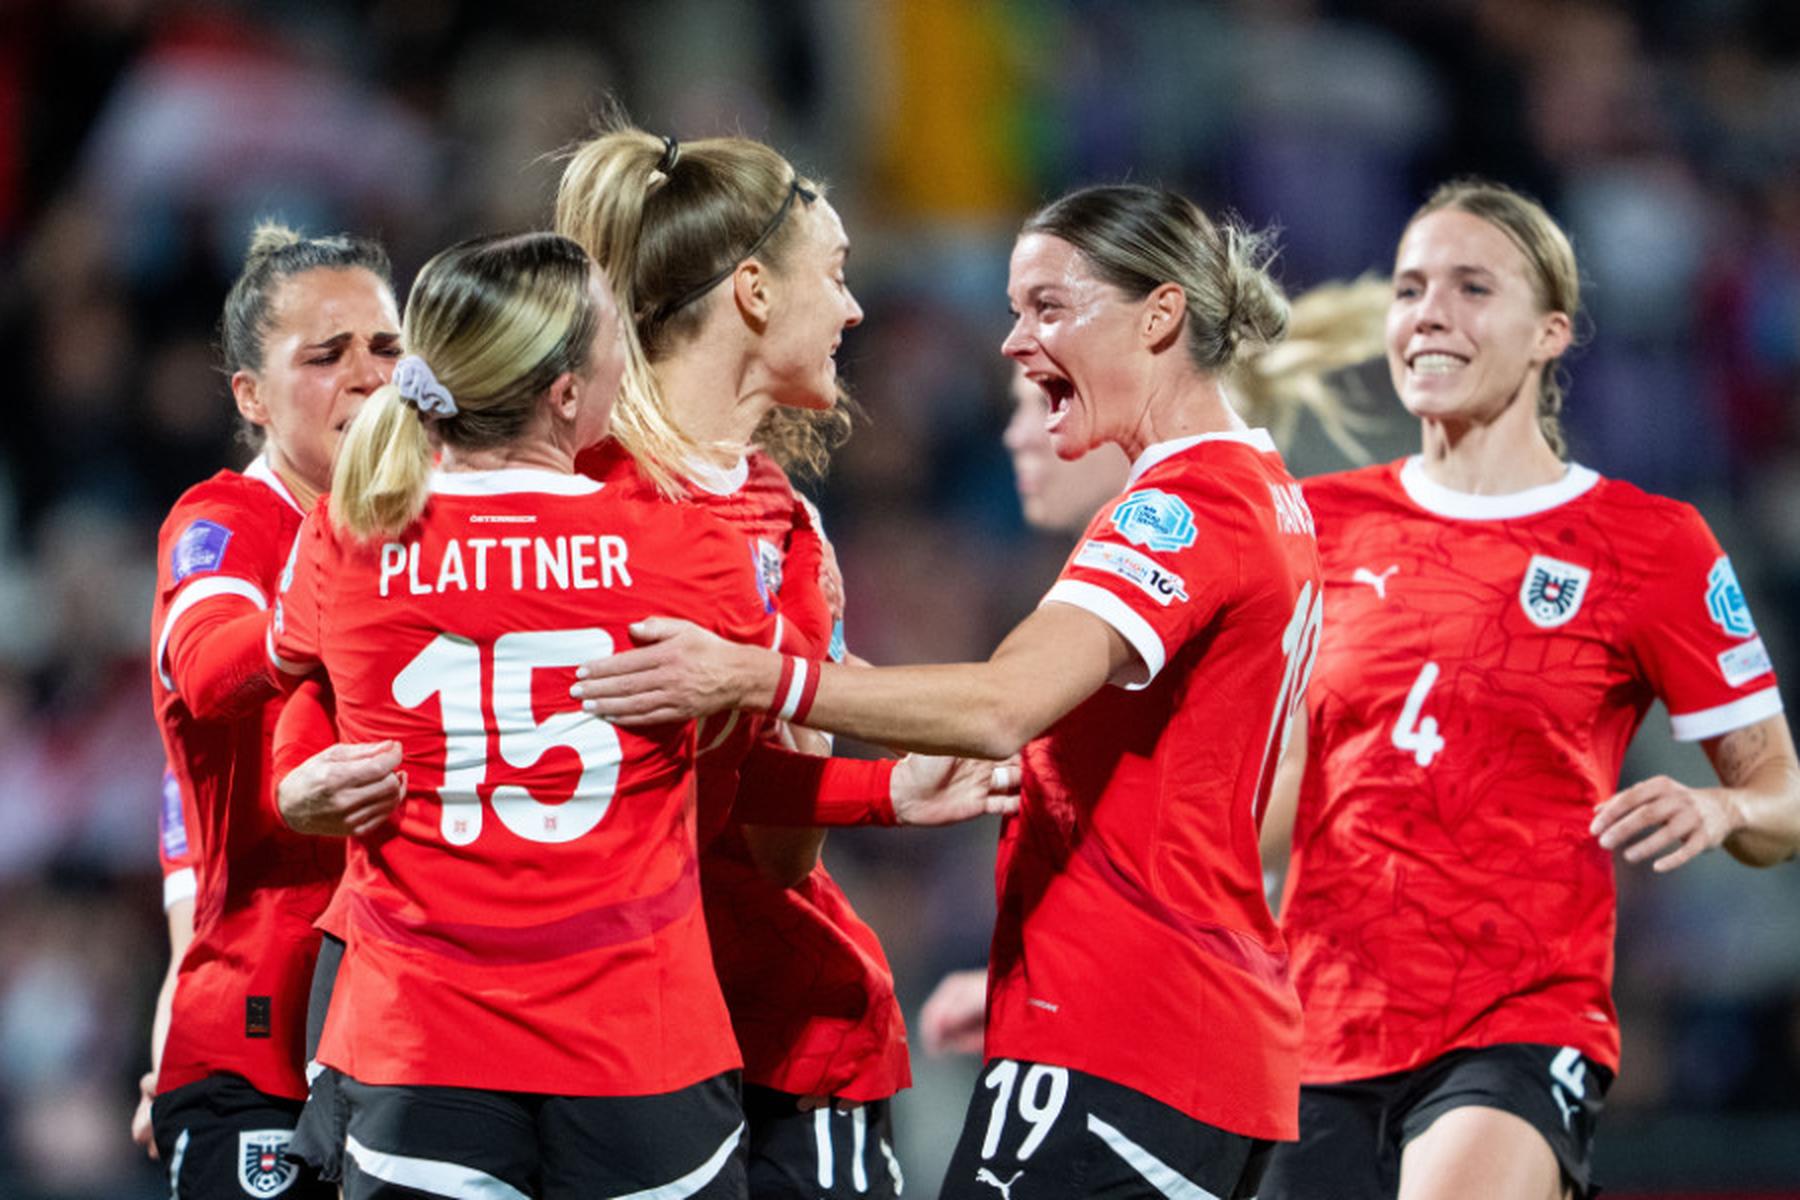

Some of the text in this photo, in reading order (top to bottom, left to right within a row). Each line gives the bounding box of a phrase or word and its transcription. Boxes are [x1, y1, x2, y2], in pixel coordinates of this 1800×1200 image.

[379, 535, 633, 597] PLATTNER
[391, 627, 624, 847] 15
[1391, 661, 1445, 768] 4
[981, 1058, 1069, 1161] 19
